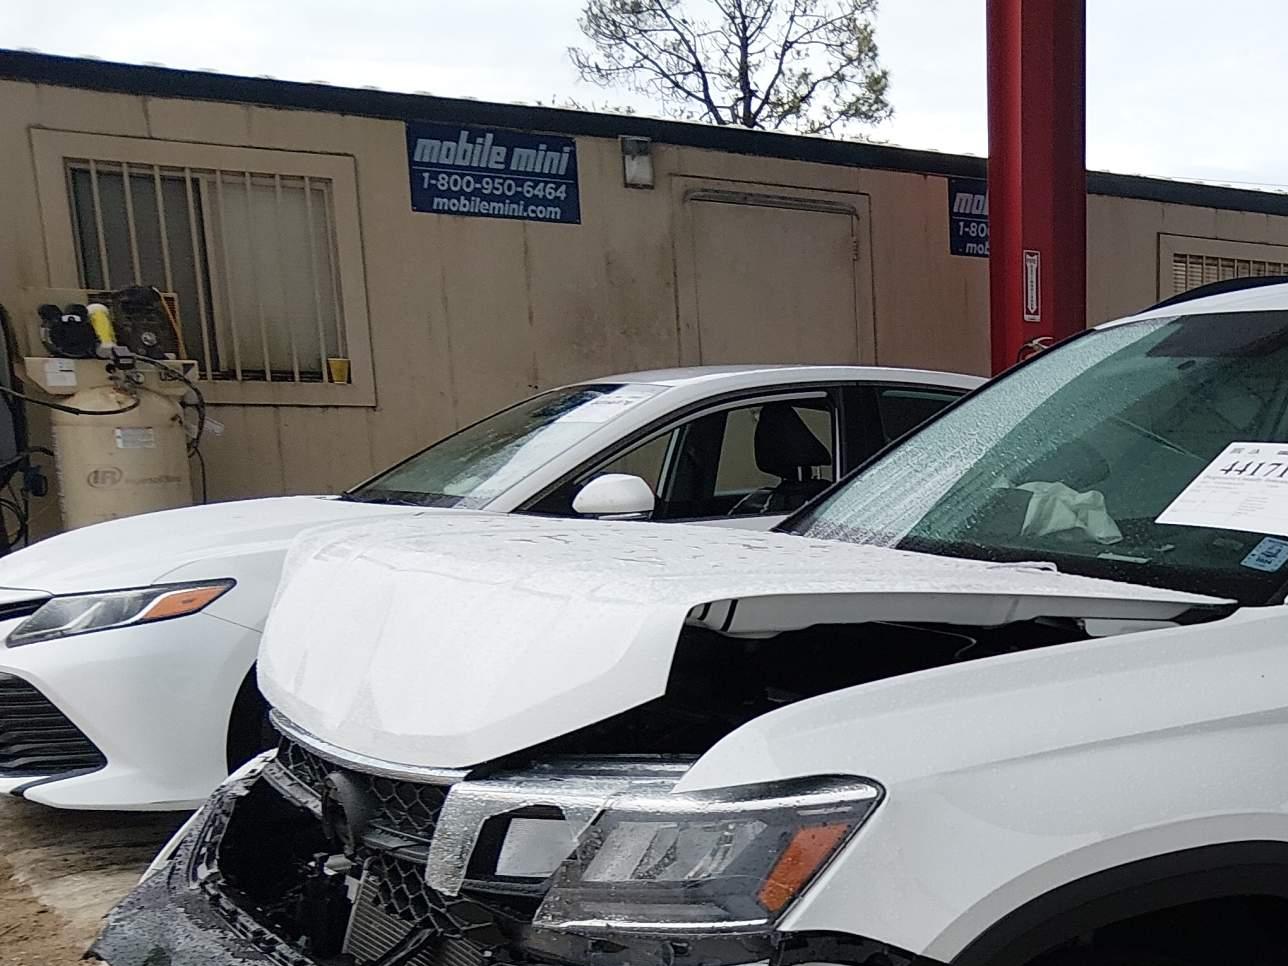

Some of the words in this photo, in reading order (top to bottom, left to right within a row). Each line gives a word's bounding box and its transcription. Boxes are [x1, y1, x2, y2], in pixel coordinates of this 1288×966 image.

[413, 131, 507, 170] mobile
[510, 144, 572, 175] mini
[422, 172, 567, 200] 1-800-950-6464
[432, 196, 562, 220] mobilemini.com
[959, 221, 990, 238] 1-80
